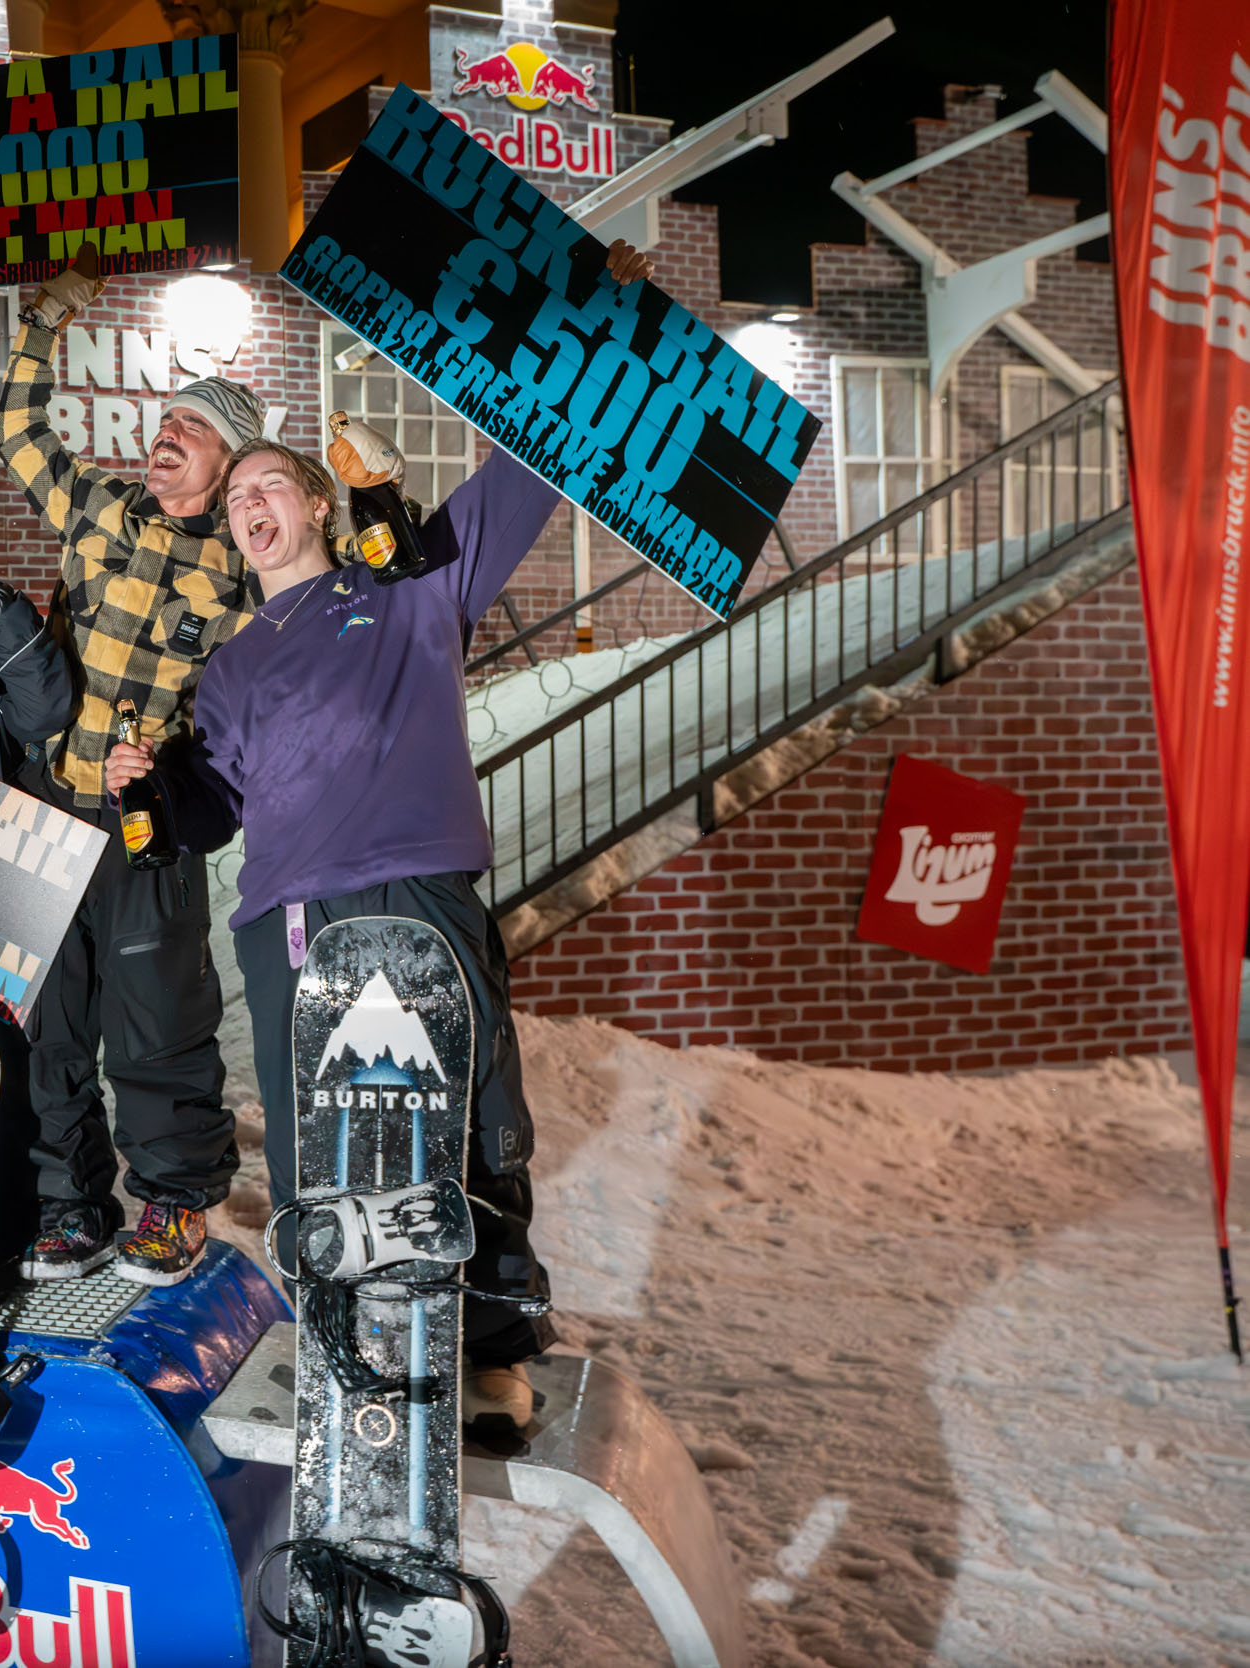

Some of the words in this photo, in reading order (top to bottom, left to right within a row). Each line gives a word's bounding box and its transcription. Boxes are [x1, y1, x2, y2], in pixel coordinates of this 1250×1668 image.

[6, 58, 58, 135] A
[69, 34, 239, 127] RAIL
[534, 120, 616, 178] Bull
[35, 188, 186, 261] MAN
[97, 248, 188, 277] OVEMBER
[363, 82, 588, 298] ROCK
[582, 266, 648, 349] A
[648, 299, 809, 485] RAIL
[1148, 81, 1220, 330] INNS'
[302, 234, 439, 347] GOPRO
[433, 336, 616, 484] CREATIVE
[602, 468, 744, 592] AWARD
[432, 237, 518, 345] €
[508, 289, 706, 494] 500
[384, 333, 445, 389] 24TH
[452, 385, 574, 489] INNSBRUCK
[581, 487, 688, 583] NOVEMBER
[326, 594, 368, 615] BURTON
[1213, 404, 1250, 708] www.innsbruck.info
[313, 1089, 448, 1111] BURTON
